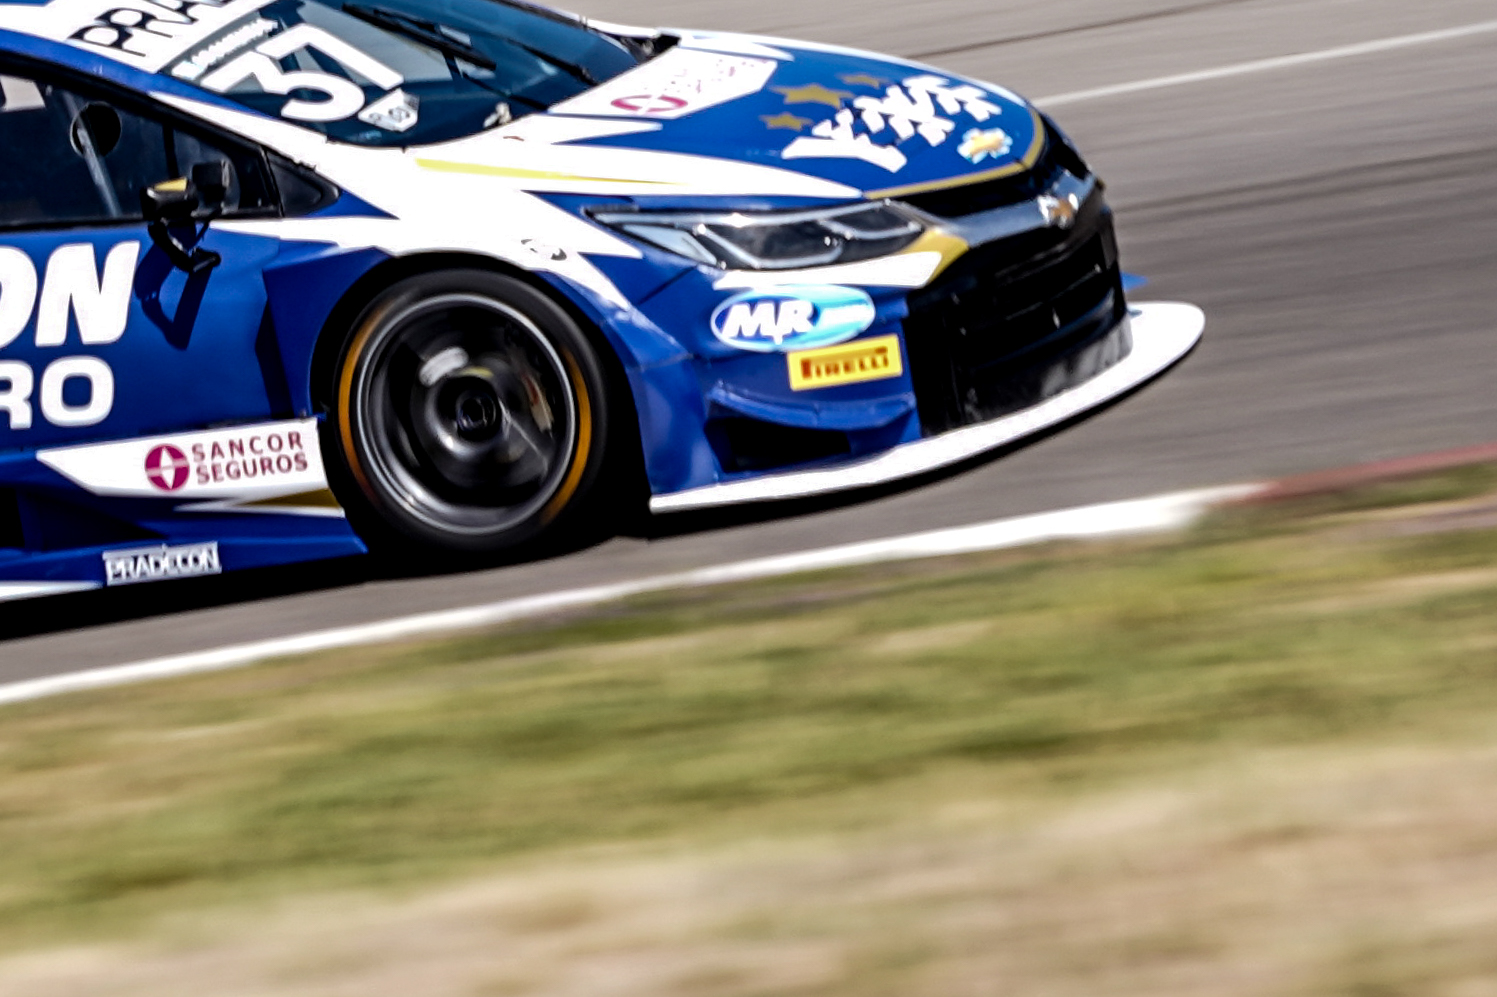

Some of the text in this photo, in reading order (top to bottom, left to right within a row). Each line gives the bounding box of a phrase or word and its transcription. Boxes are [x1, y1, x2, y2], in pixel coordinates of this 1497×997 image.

[200, 23, 404, 121] 37
[191, 431, 304, 462] SANCOR
[196, 452, 308, 485] SEGUROS
